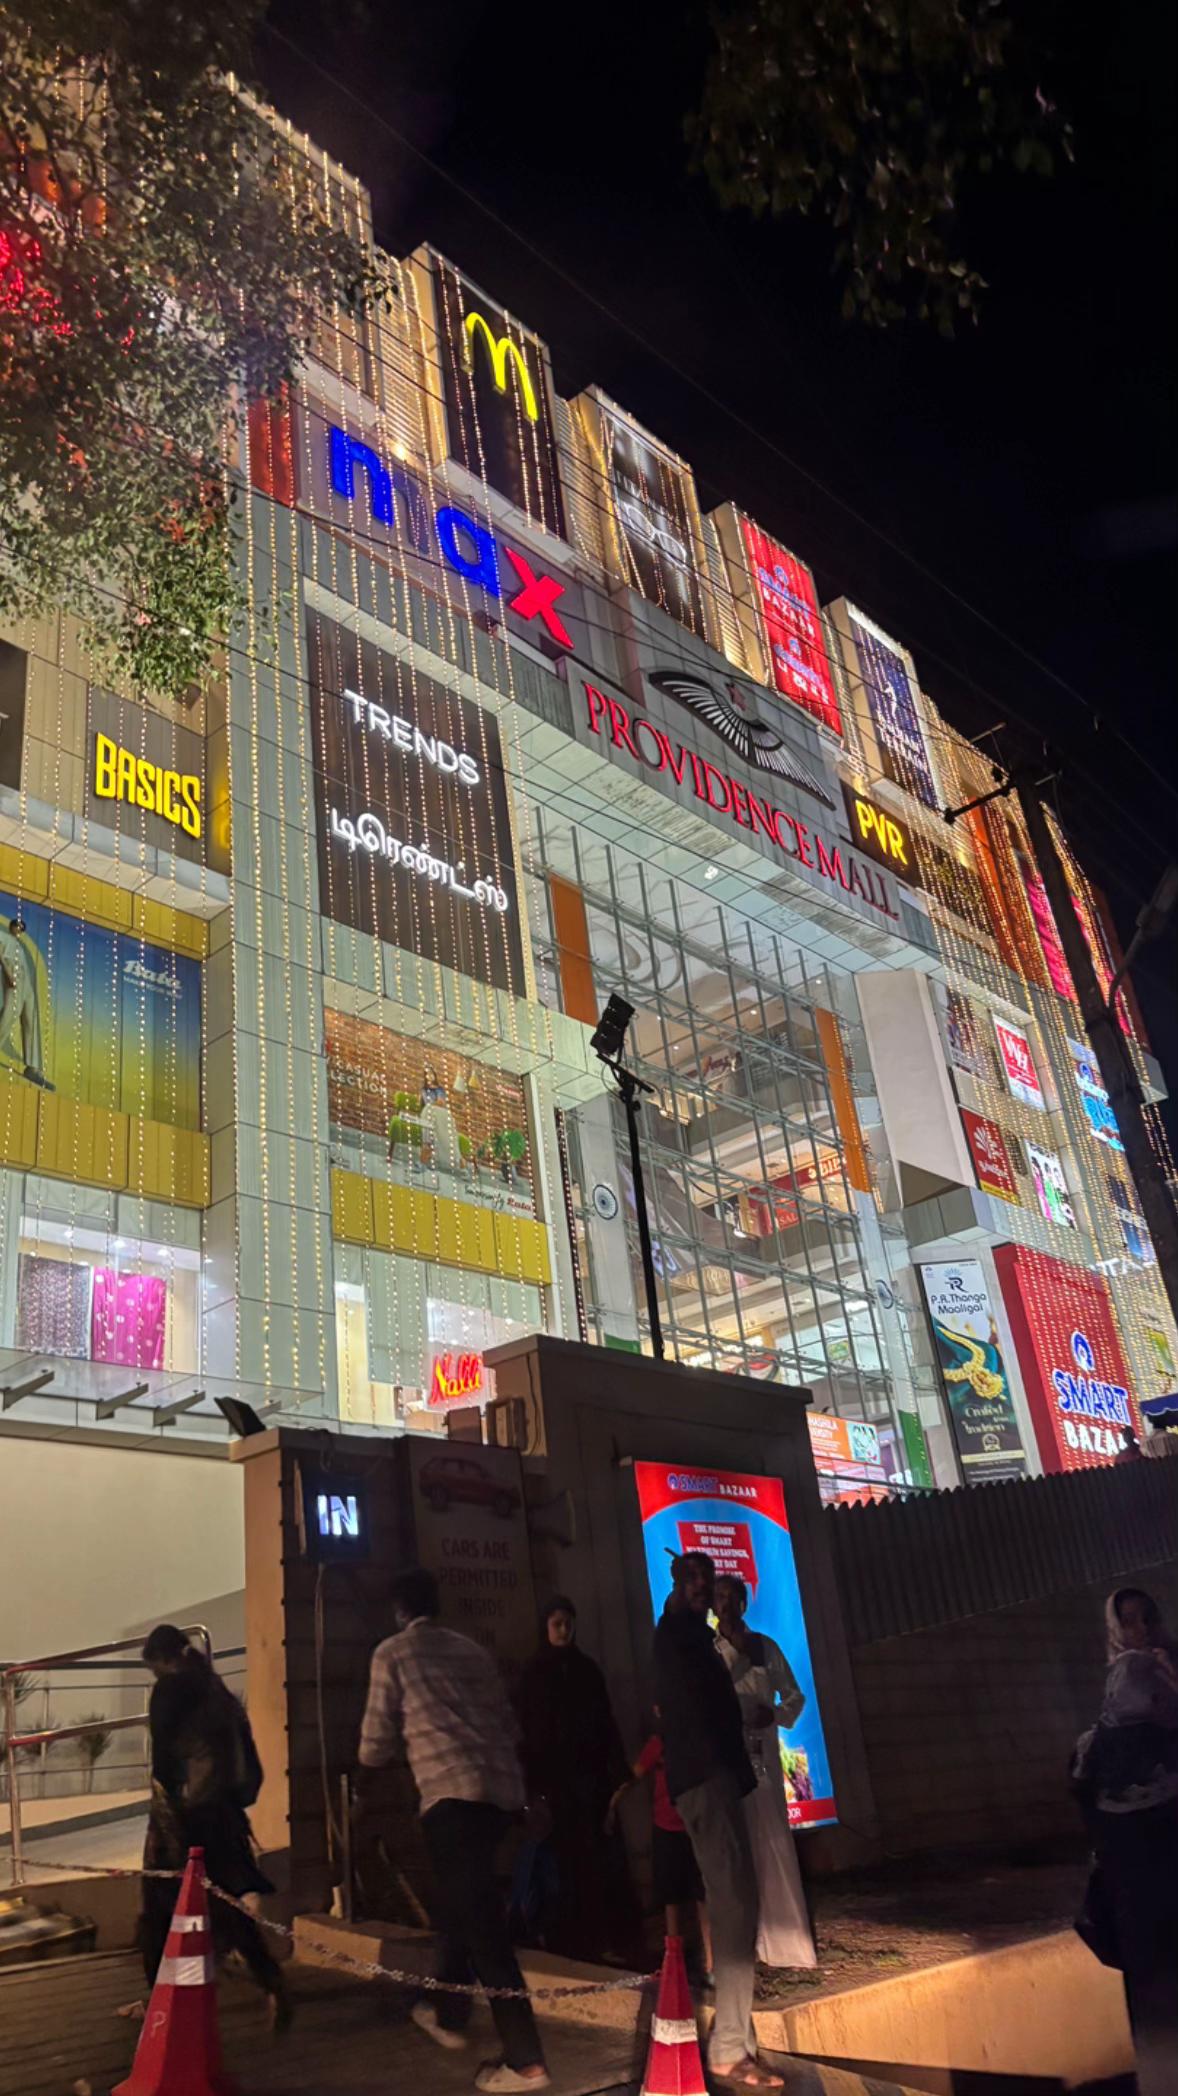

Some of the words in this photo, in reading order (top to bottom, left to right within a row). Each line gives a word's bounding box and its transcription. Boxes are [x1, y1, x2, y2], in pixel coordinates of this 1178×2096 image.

[330, 424, 574, 650] max
[343, 688, 481, 785] TRENDS
[96, 731, 202, 839] BASICS
[582, 681, 816, 869] PROVIDENCE
[814, 834, 899, 921] MALL
[855, 800, 908, 865] PVR
[430, 1352, 483, 1405] Nalli
[1052, 1367, 1131, 1425] SMART
[317, 1494, 360, 1536] IN
[681, 1474, 718, 1493] SMART
[719, 1484, 758, 1498] BAZAAR
[482, 1541, 511, 1560] ARE
